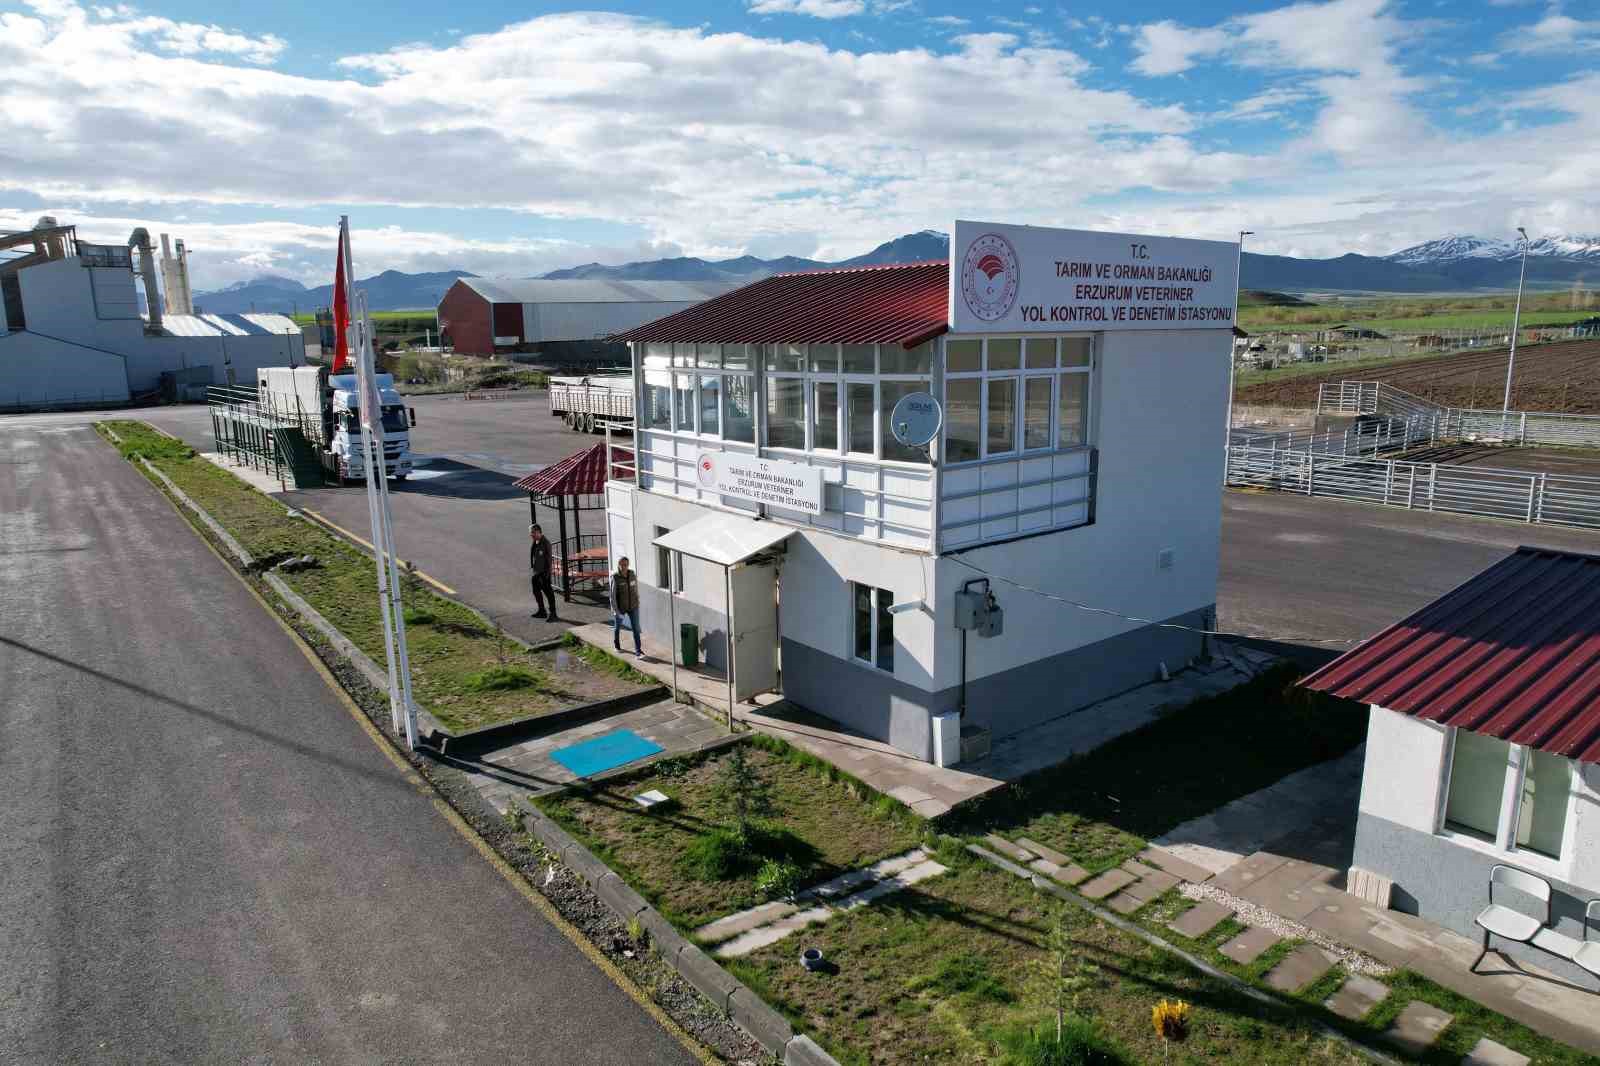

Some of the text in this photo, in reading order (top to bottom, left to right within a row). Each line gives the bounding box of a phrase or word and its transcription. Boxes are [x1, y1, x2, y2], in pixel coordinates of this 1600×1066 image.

[1131, 244, 1150, 259] T.C.
[1055, 262, 1212, 282] TARIM VE ORMAN BAKANLIĞI
[1076, 283, 1194, 301] ERZURUM VETERİNER
[1021, 304, 1232, 322] YOL KONTROL VE DENETİM İSTASYONU
[738, 478, 762, 489] ERZURUM
[745, 470, 752, 478] VE
[752, 471, 773, 482] ORMAN
